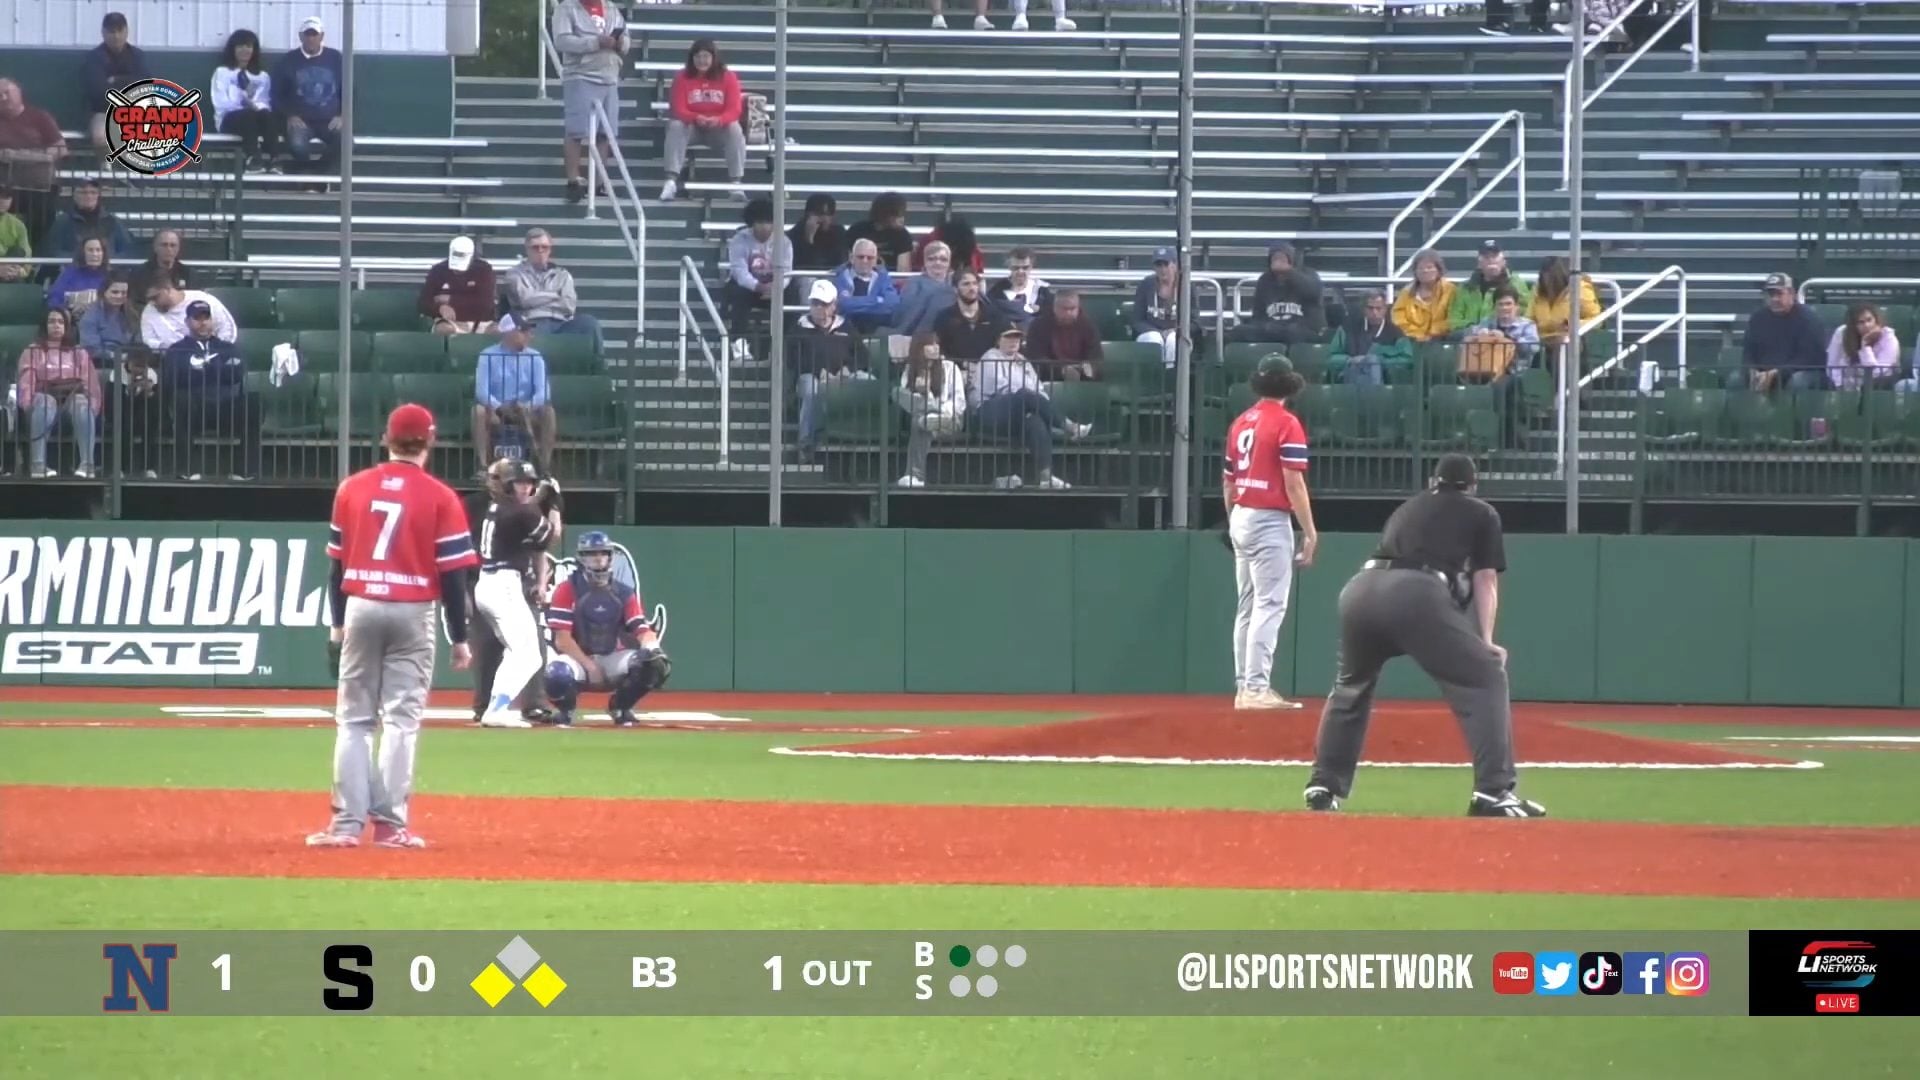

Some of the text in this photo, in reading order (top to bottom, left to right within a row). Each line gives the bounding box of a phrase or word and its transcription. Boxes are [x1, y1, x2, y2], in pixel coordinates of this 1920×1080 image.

[1236, 427, 1255, 471] 9
[371, 500, 402, 560] 7
[0, 536, 333, 627] RMINGDAL
[16, 640, 243, 665] STATE
[257, 665, 272, 675] TM
